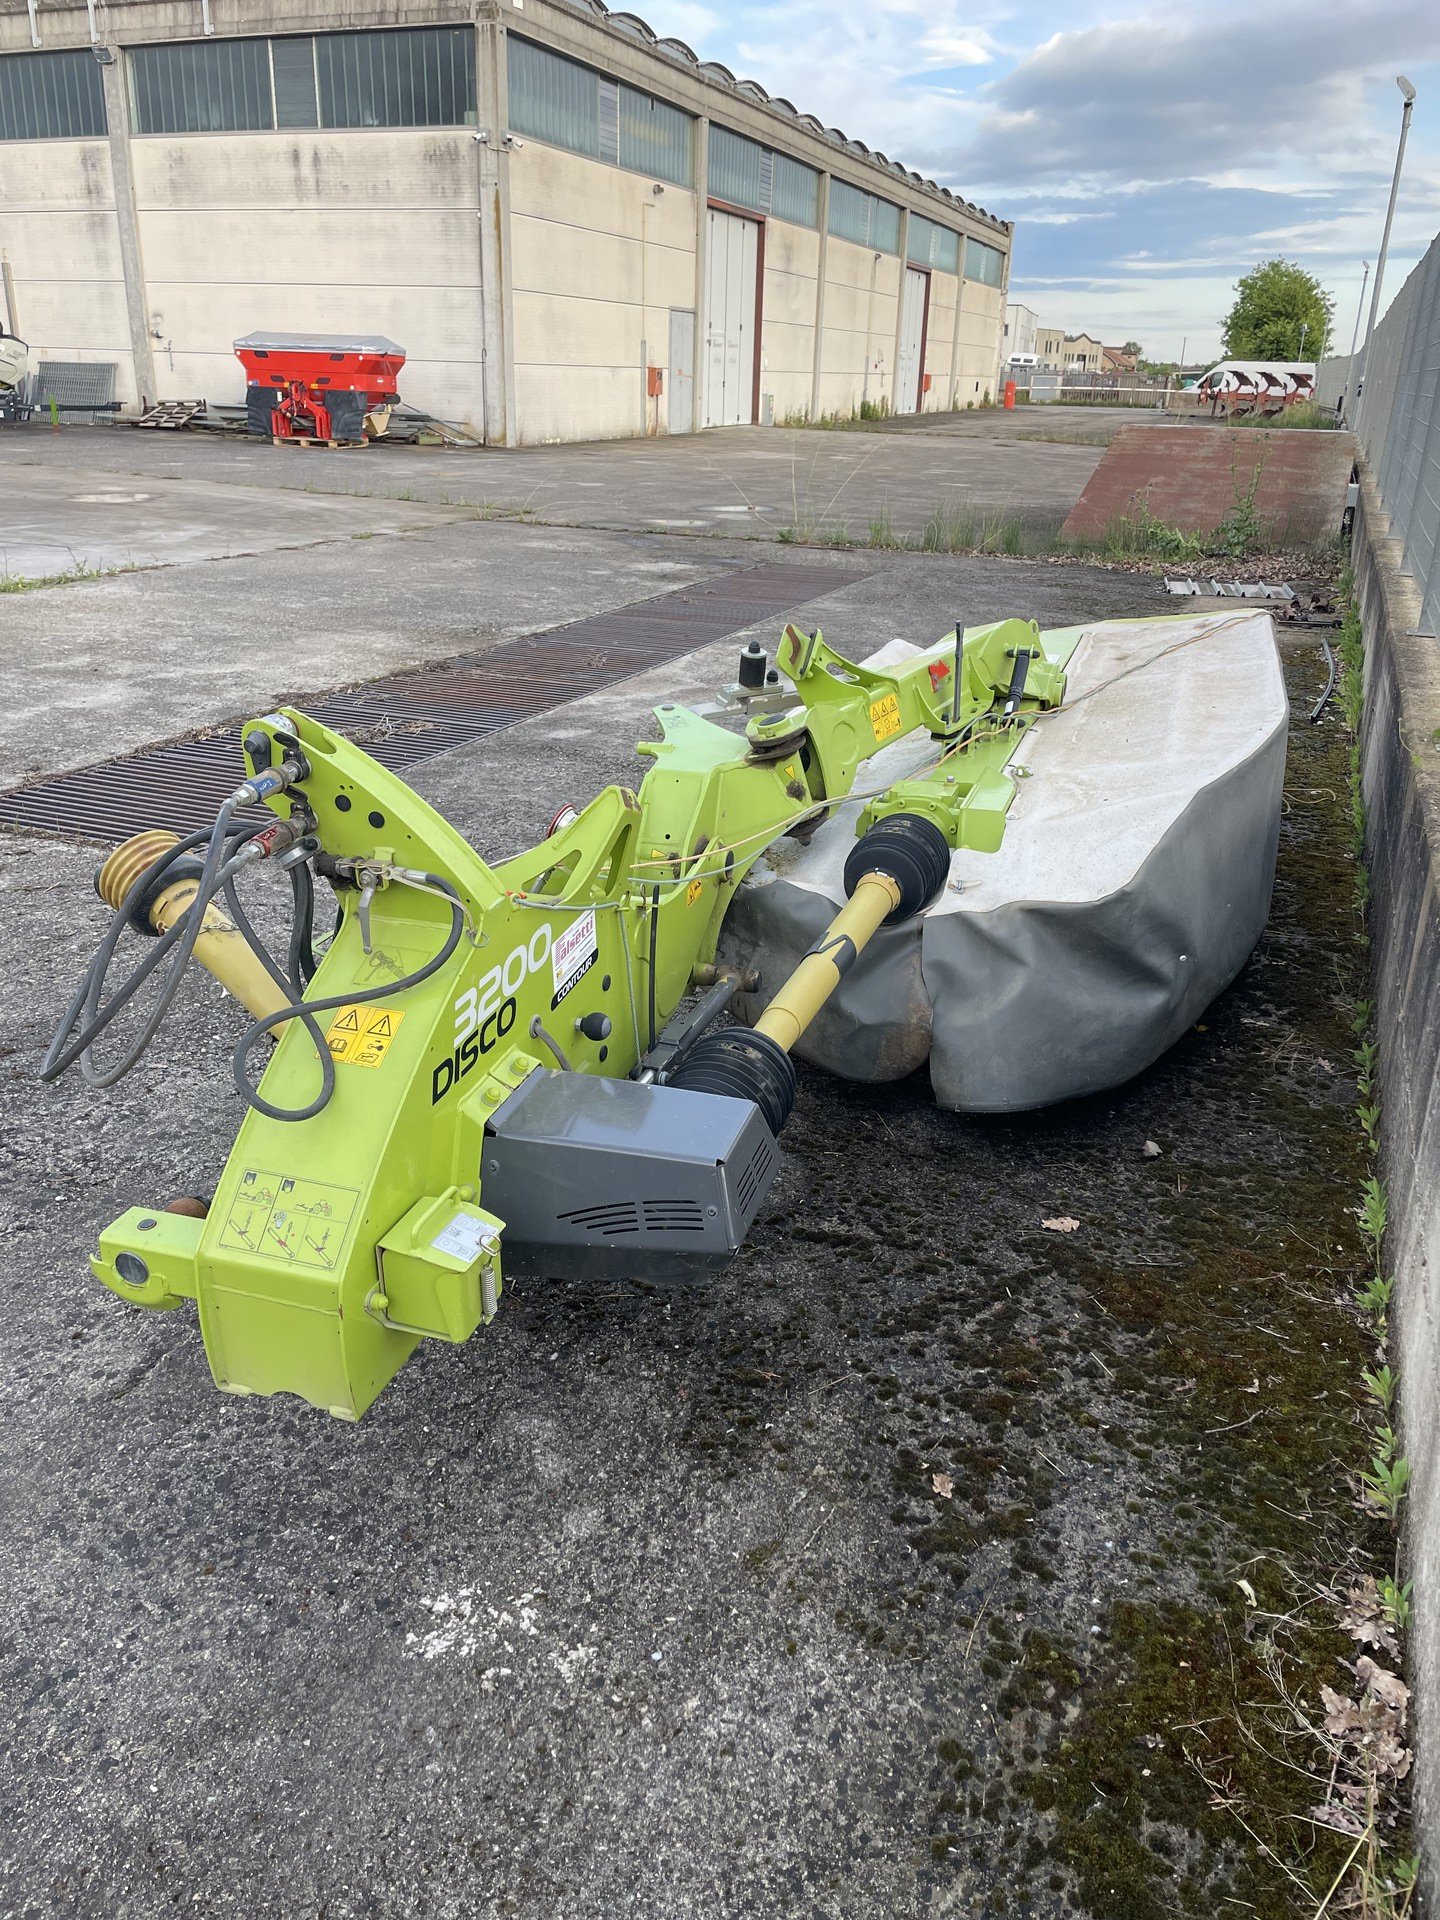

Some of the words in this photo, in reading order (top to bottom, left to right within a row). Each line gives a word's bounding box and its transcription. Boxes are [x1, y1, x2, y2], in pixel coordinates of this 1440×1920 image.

[454, 923, 552, 1048] 3200
[557, 956, 593, 1003] CONTOUR
[432, 997, 517, 1106] DISCO
